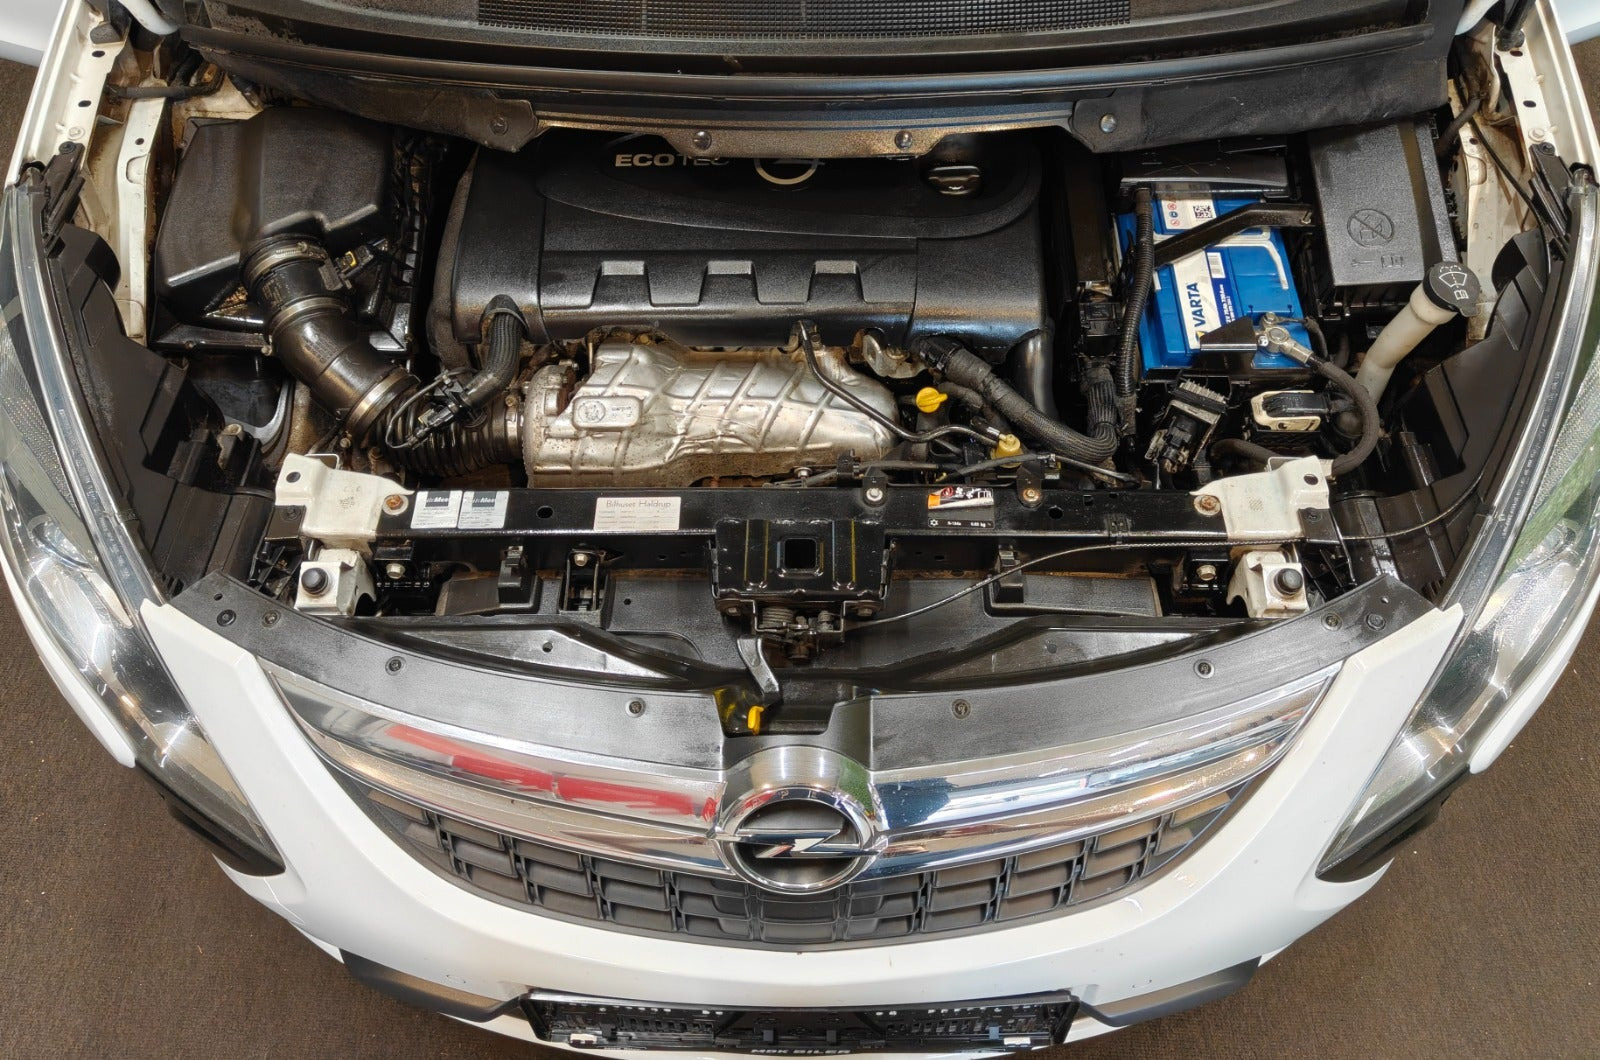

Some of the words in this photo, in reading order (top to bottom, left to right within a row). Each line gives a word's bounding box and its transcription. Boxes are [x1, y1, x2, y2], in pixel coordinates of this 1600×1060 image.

[1186, 282, 1206, 327] VARTA
[606, 499, 636, 508] Bilhuset
[638, 499, 671, 509] Haldrup
